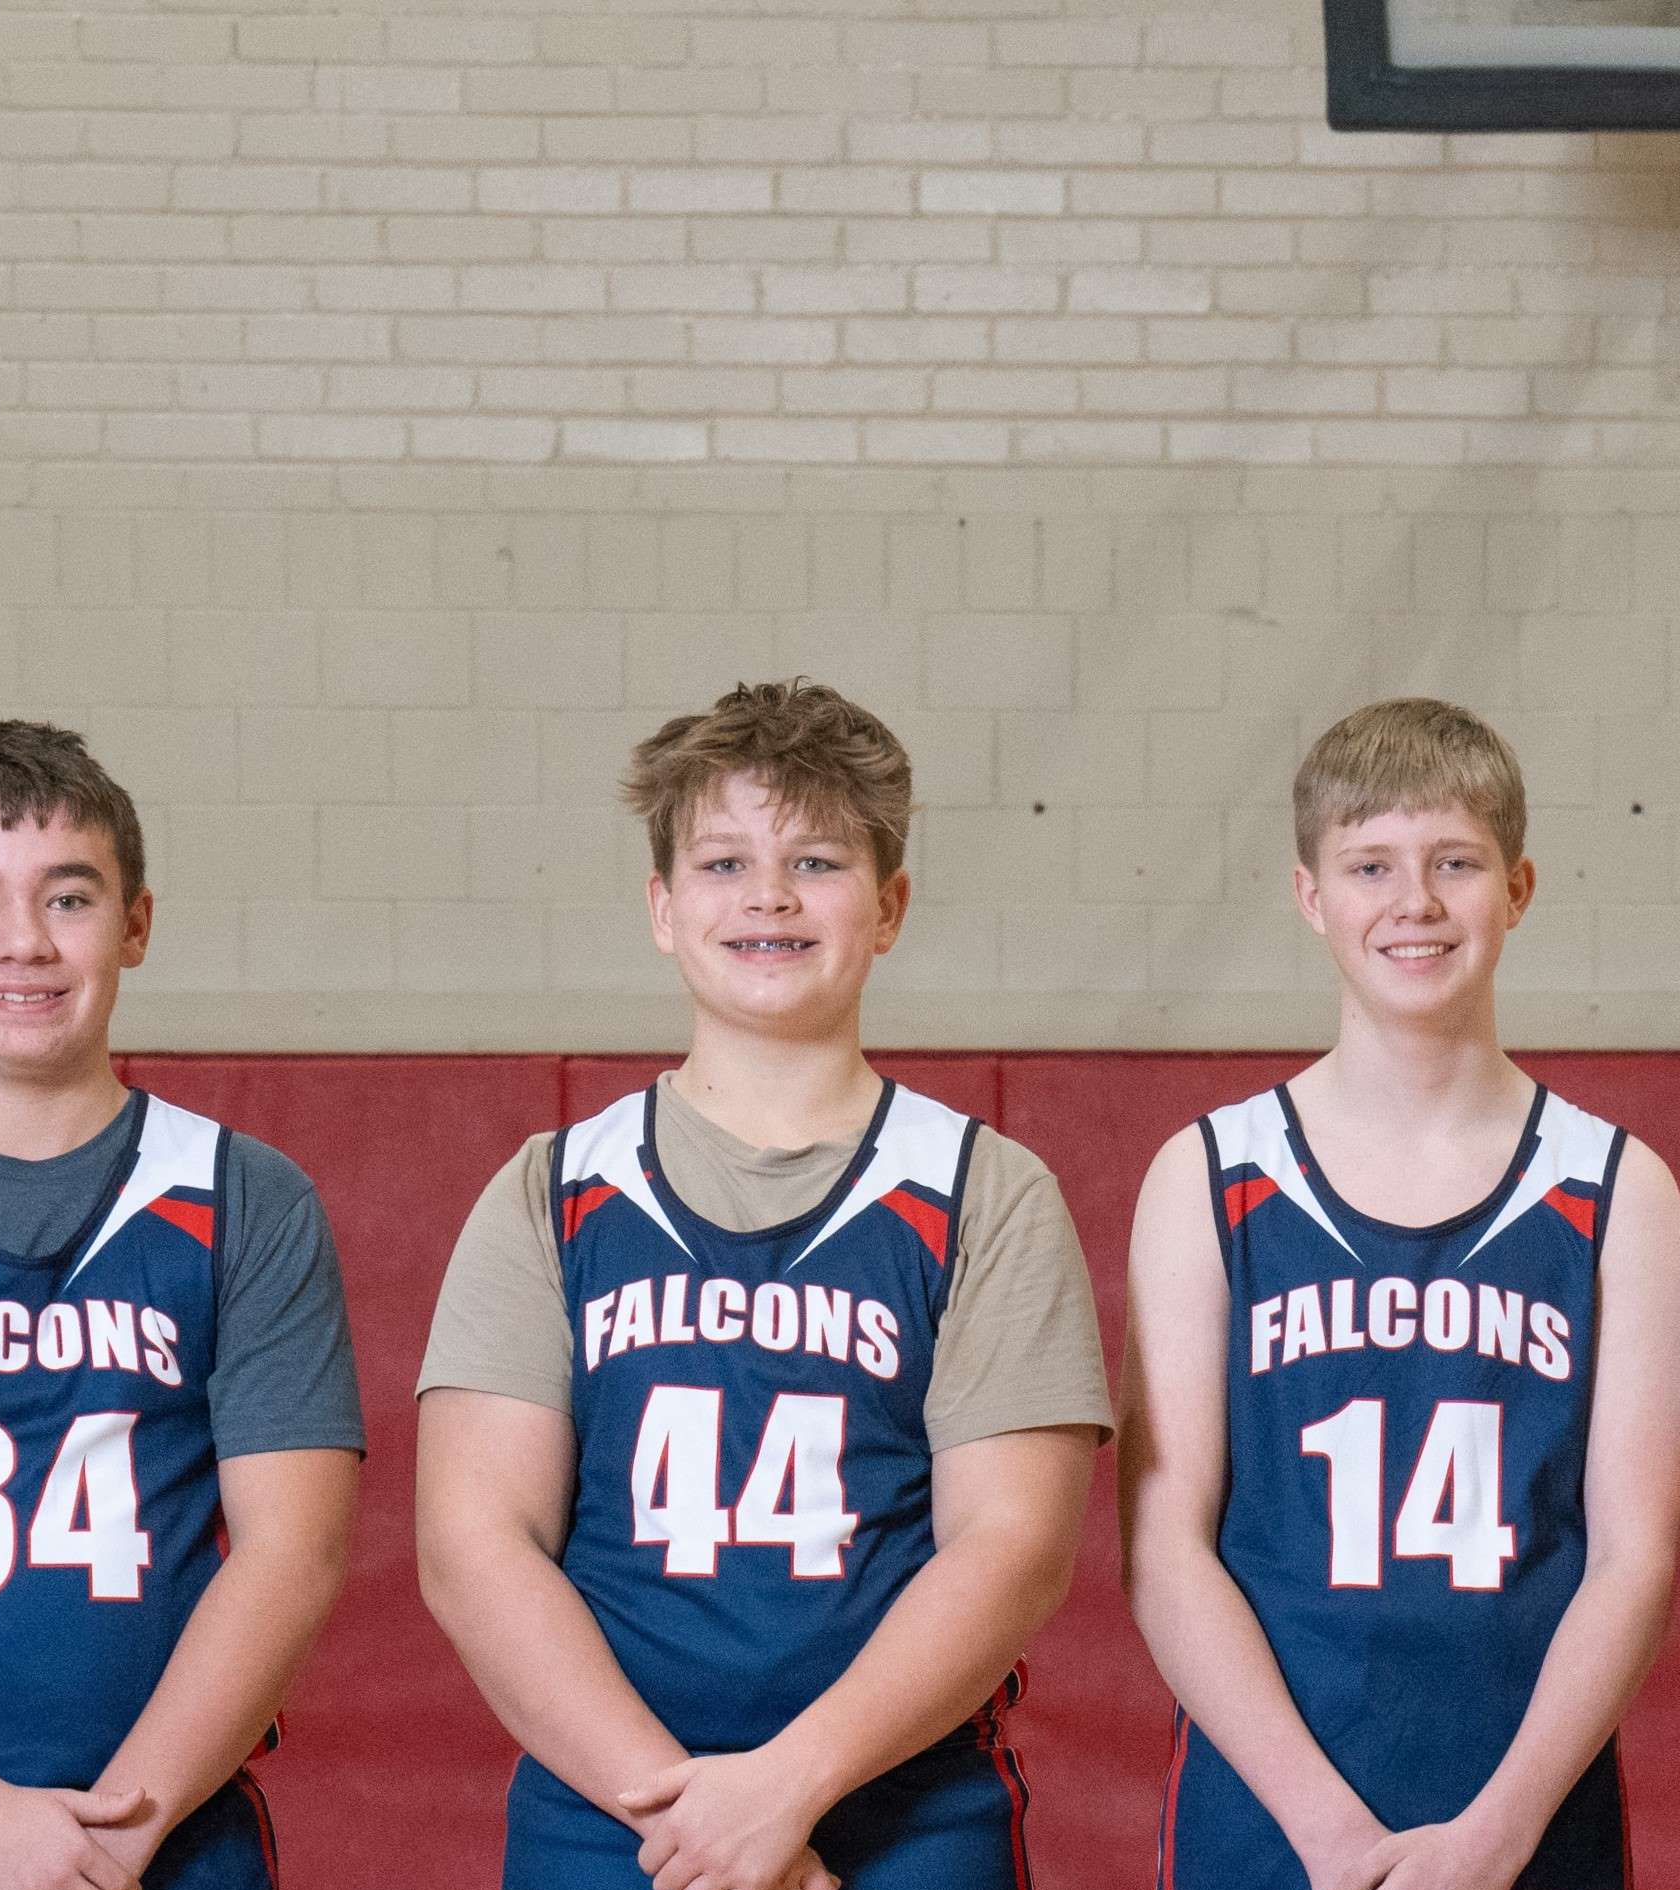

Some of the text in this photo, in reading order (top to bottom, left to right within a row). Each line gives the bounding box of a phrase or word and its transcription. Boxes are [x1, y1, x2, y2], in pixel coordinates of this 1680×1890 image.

[584, 1273, 900, 1380] FALCONS
[1250, 1276, 1572, 1382] FALCONS
[631, 1383, 861, 1580] 44
[1301, 1397, 1517, 1592] 14
